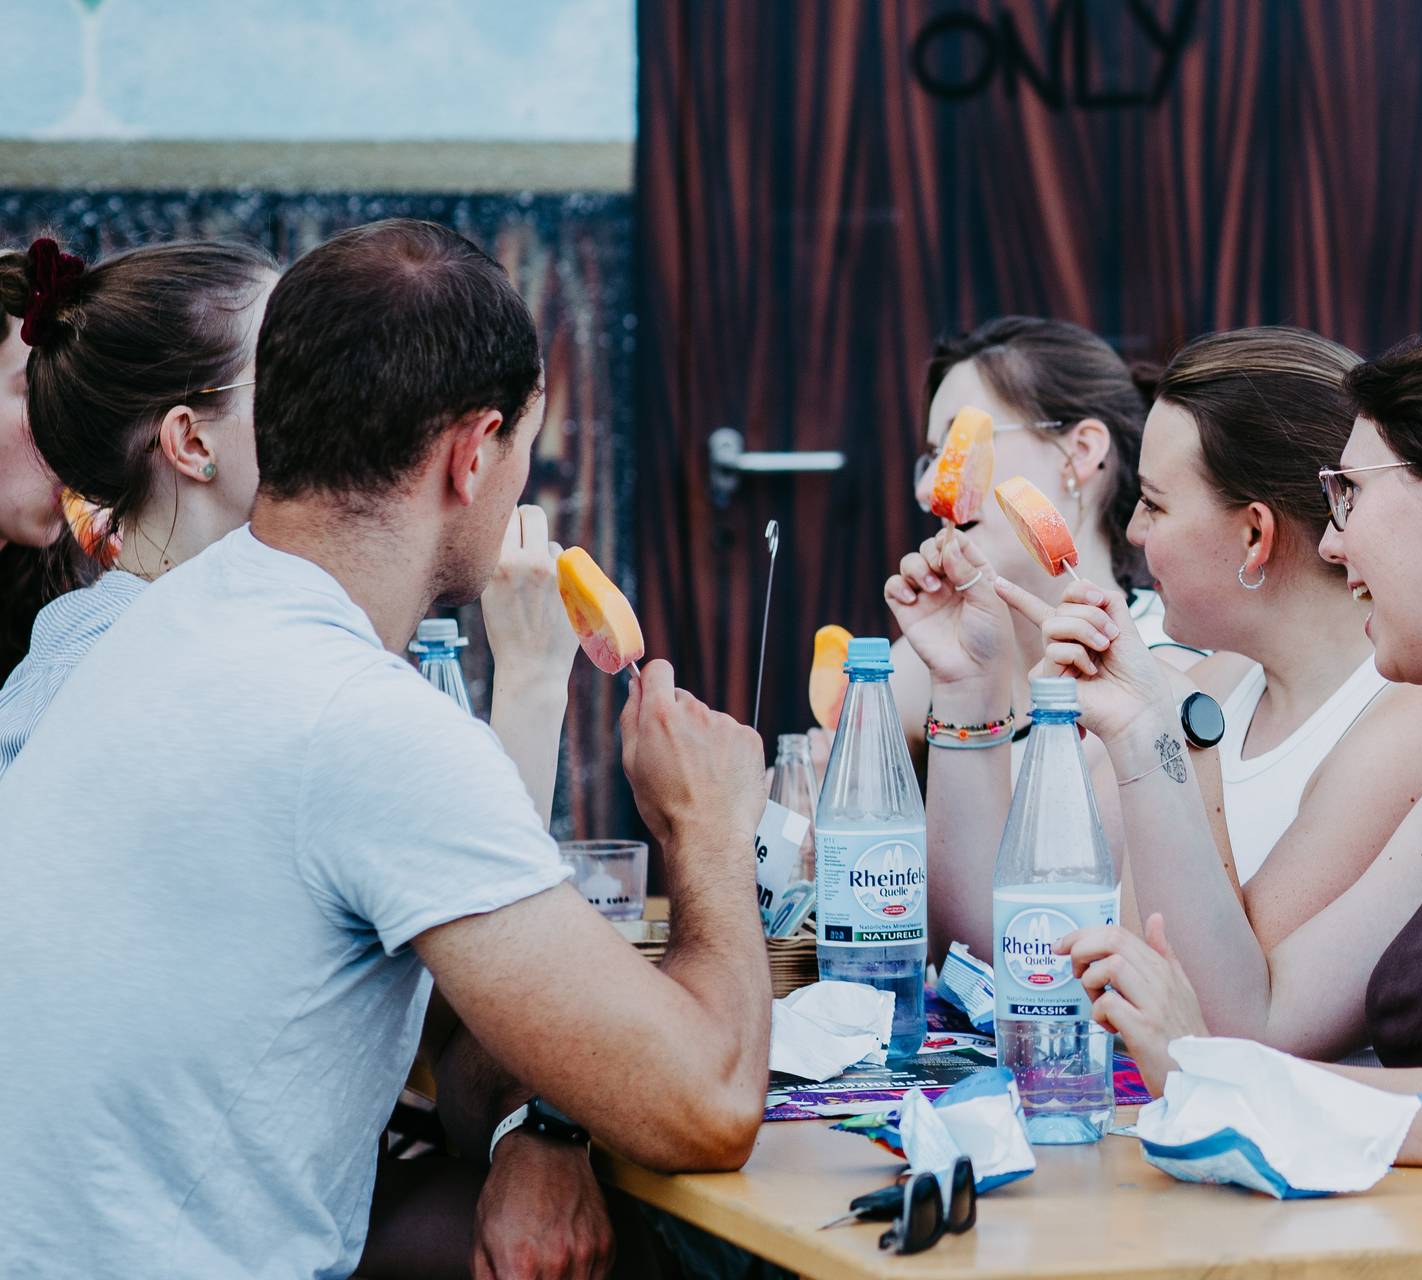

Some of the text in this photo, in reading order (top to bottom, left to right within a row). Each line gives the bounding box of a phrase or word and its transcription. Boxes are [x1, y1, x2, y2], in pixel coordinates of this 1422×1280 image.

[910, 0, 1200, 112] ONLY
[849, 867, 925, 887] Rheinfels
[880, 886, 909, 897] Quelle
[862, 929, 921, 941] NATURELLE
[1002, 936, 1053, 955] Rhein
[1025, 956, 1057, 966] Quelle
[1017, 1005, 1068, 1015] KLASSIK
